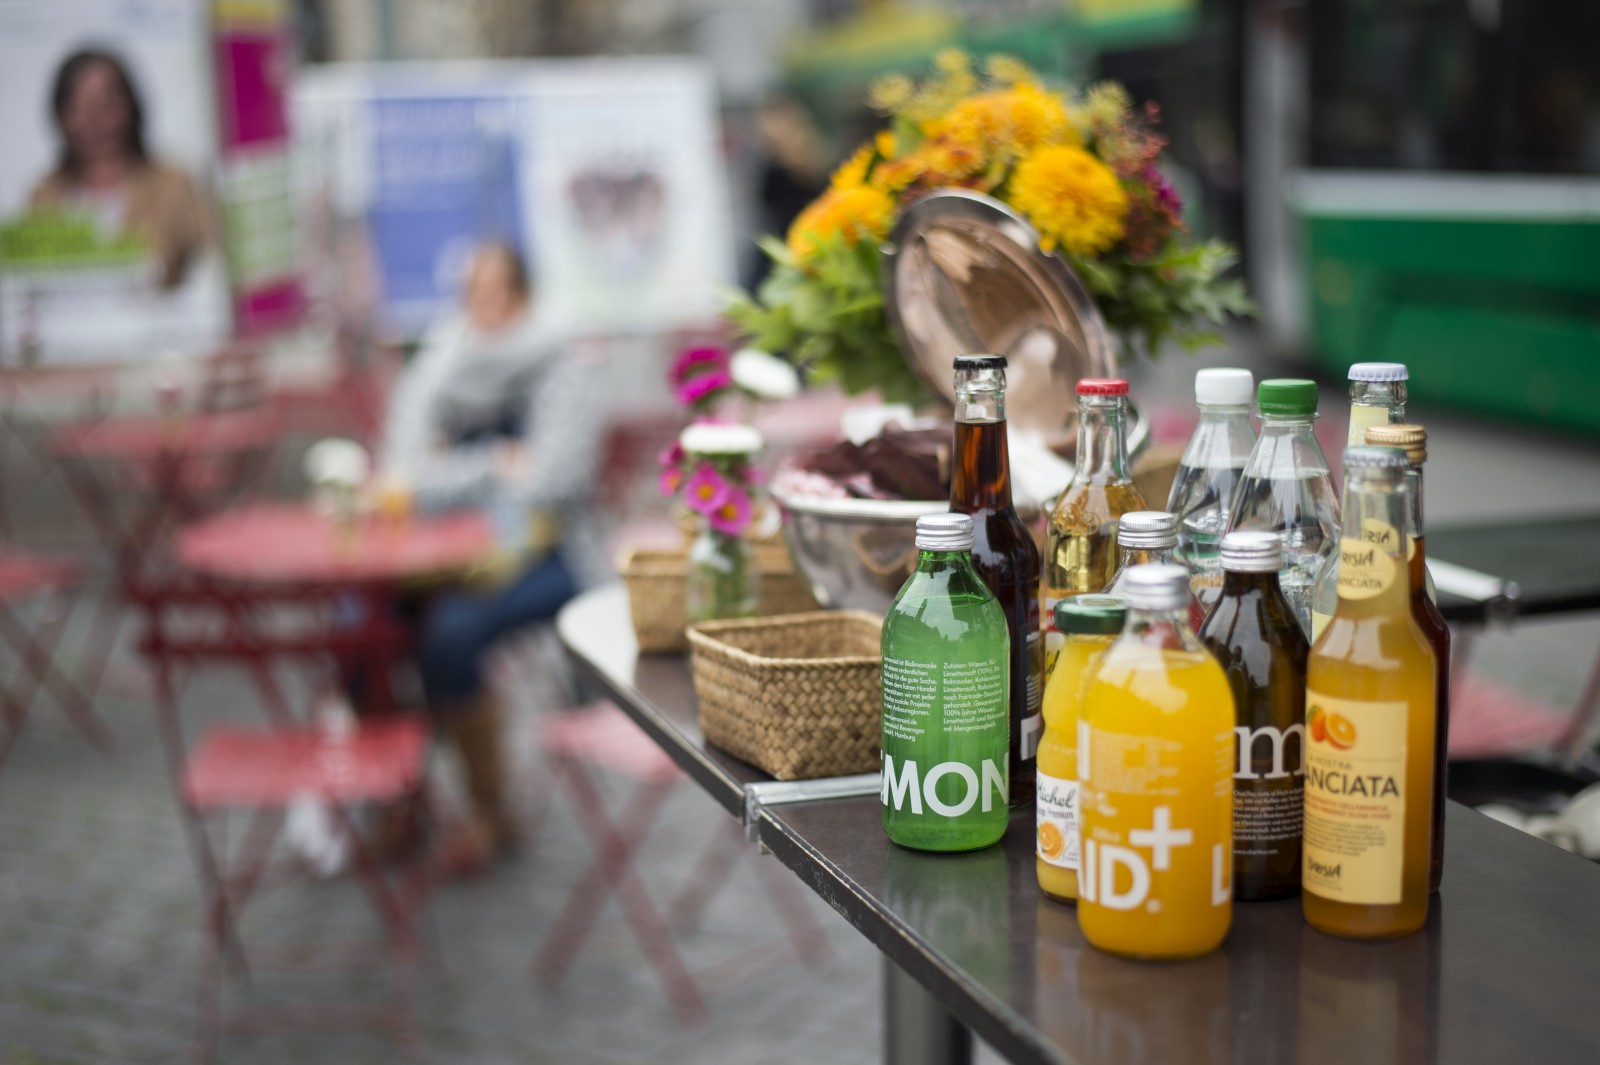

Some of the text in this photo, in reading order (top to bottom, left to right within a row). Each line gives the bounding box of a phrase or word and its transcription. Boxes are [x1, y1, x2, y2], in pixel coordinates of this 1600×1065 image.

[943, 669, 977, 677] Limettensaft
[917, 685, 937, 693] Handel
[943, 693, 957, 701] nach
[909, 699, 931, 708] Projekte
[943, 716, 976, 724] Limettensaft
[881, 750, 1009, 817] MON
